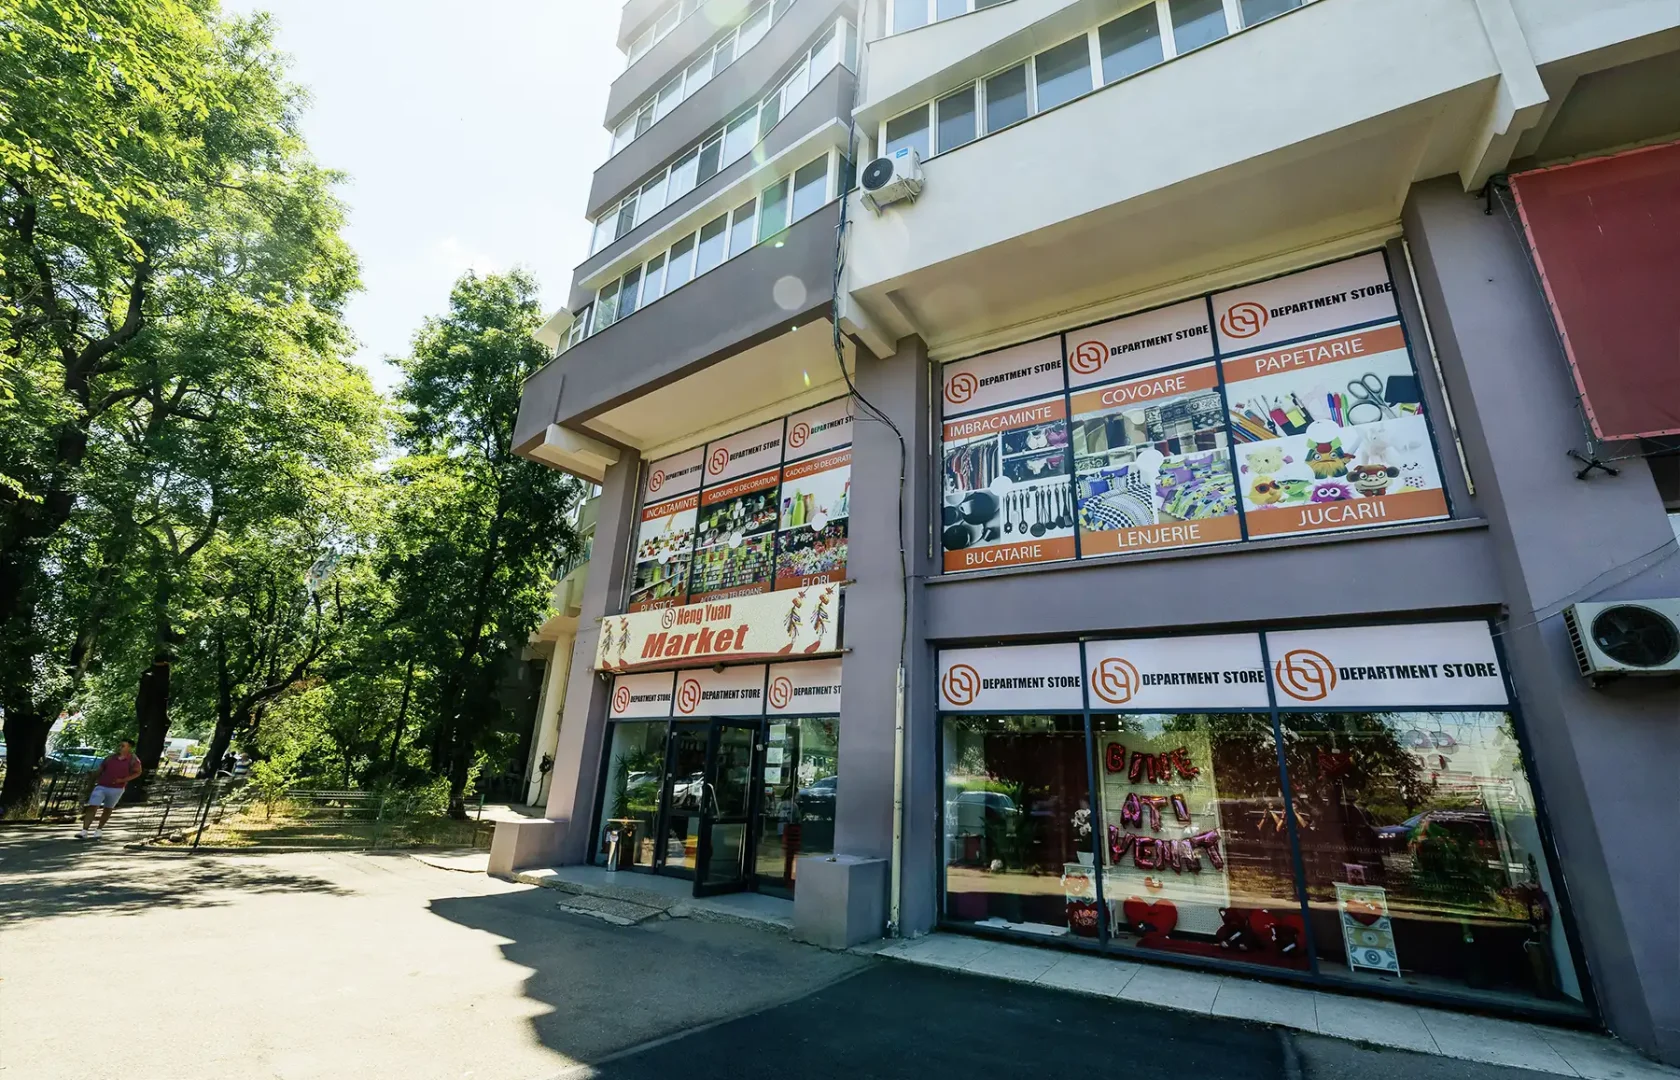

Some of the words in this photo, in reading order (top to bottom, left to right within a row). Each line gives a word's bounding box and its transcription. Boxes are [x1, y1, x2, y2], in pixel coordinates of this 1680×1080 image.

[1270, 292, 1348, 319] DEPARTMENT
[1350, 282, 1393, 300] STORE
[1110, 333, 1173, 356] DEPARTMENT
[1176, 324, 1209, 340] STORE
[1255, 338, 1365, 373] PAPETARIE
[979, 367, 1032, 387] DEPARTMENT
[1034, 360, 1062, 373] STORE
[1102, 376, 1187, 405] COVOARE
[811, 418, 844, 435] DEPARTMENT
[950, 406, 1052, 437] IMBRACAMINTE
[729, 445, 762, 461] DEPARTMENT
[763, 439, 780, 451] STORE
[785, 465, 813, 478] CADOURI
[708, 489, 733, 501] CADOURI
[739, 475, 777, 492] DECORATIUNI
[646, 497, 698, 518] INCALTAMINTE
[1298, 501, 1386, 526] JUCARII
[1117, 524, 1201, 548] LENJERIE
[966, 544, 1042, 566] BUCATARIE
[801, 574, 830, 587] FLORI
[676, 607, 703, 625] Heng
[705, 604, 732, 621] Yuan
[641, 624, 750, 659] Market
[982, 677, 1045, 690] DEPARTMENT
[1047, 676, 1081, 689] STORE
[1142, 672, 1220, 686] DEPARTMENT
[1223, 670, 1265, 684] STORE
[1339, 664, 1438, 681] DEPARTMENT
[1443, 663, 1498, 678] STORE
[630, 694, 656, 703] DEPARTMENT
[657, 693, 671, 702] STORE
[702, 689, 739, 700] DEPARTMENT
[740, 688, 761, 699] STORE
[794, 686, 832, 696] DEPARTMENT
